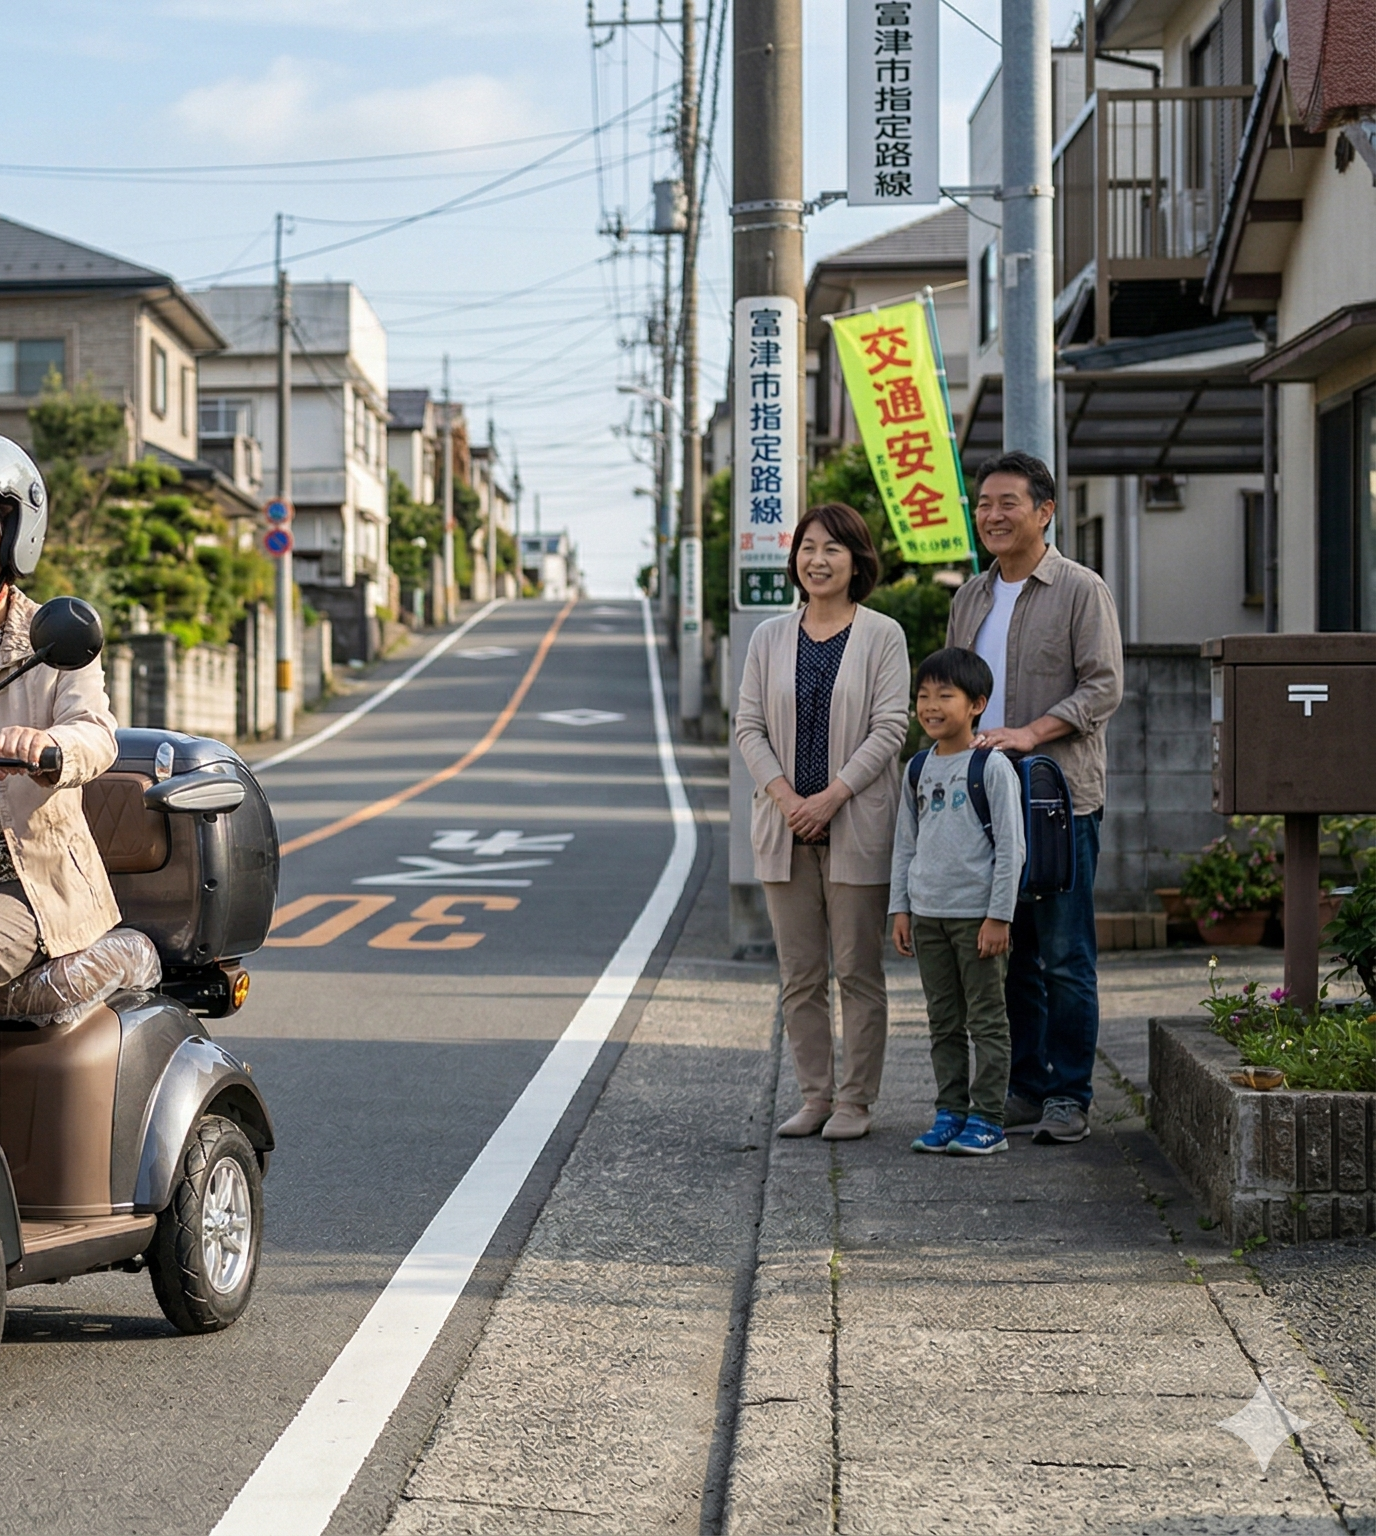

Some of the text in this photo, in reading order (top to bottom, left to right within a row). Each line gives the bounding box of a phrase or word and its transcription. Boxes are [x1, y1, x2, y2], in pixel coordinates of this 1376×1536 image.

[874, 1, 913, 198] 富津市指定路線
[749, 307, 783, 525] 富津市指定路線
[860, 326, 949, 529] 交通安全
